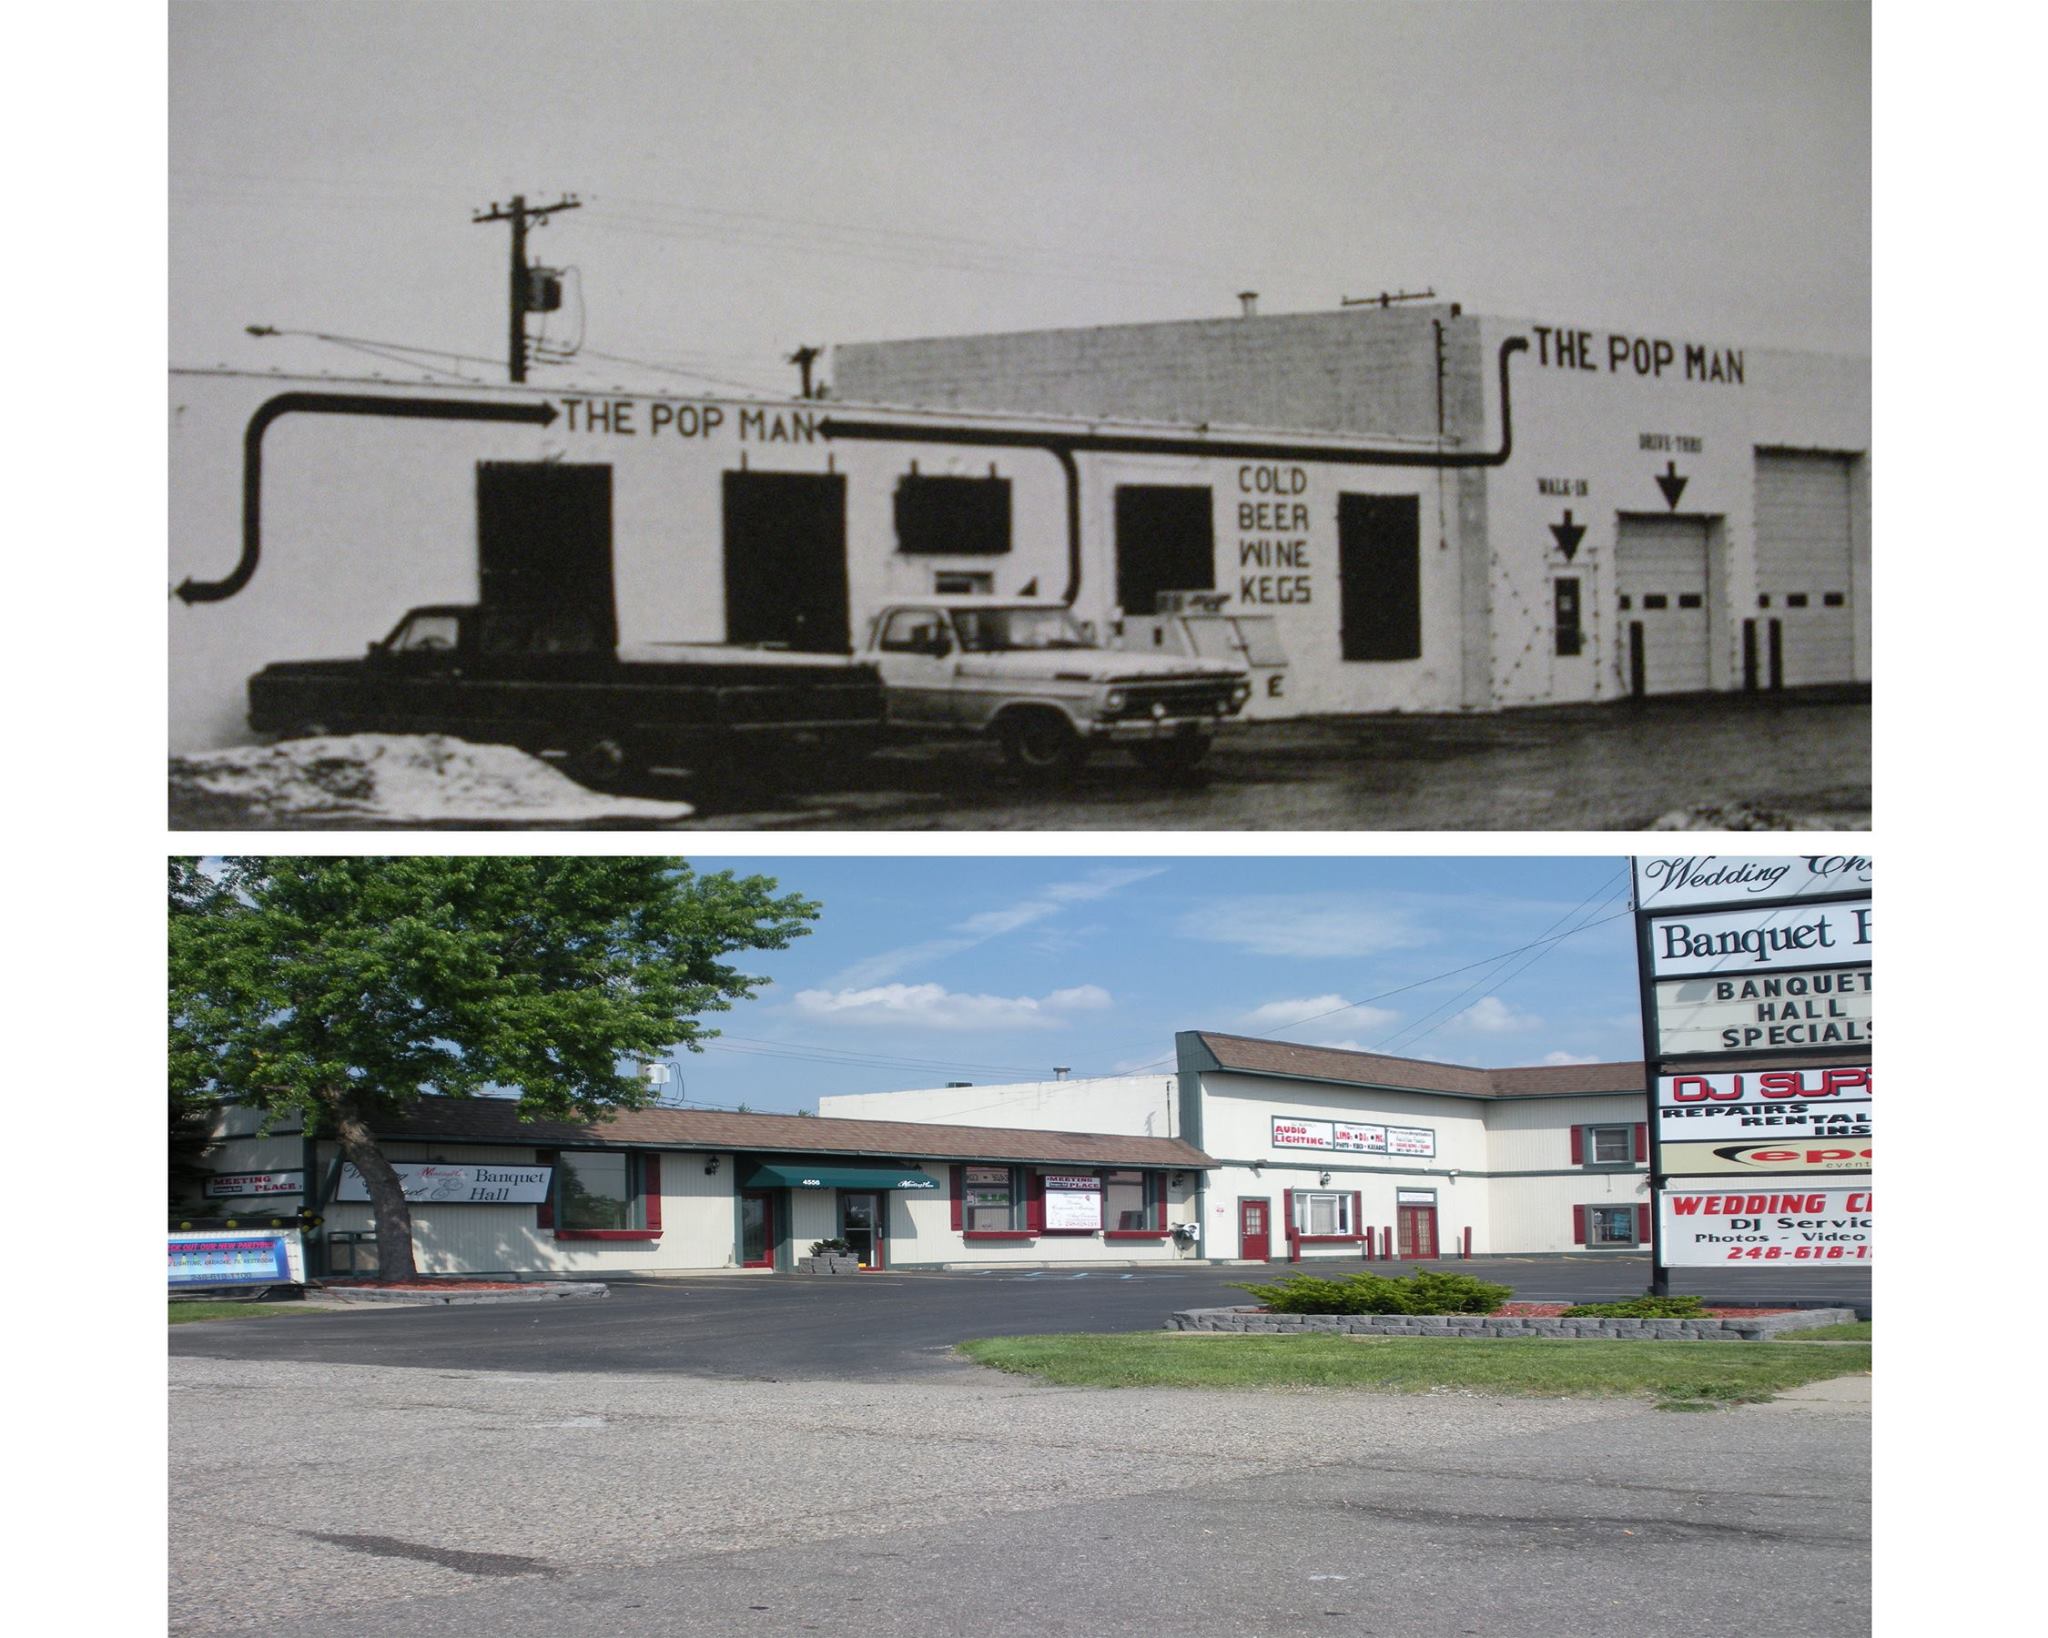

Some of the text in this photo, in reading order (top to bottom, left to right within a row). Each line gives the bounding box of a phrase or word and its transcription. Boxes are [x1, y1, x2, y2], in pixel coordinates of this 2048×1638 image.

[1533, 326, 1744, 384] THE POP MAN
[561, 399, 814, 443] THE POP MAN
[1238, 466, 1307, 495] COLD
[1537, 477, 1589, 497] WALK-IN
[1238, 502, 1309, 531] BEER
[1239, 540, 1311, 568] WINE
[1240, 575, 1312, 604] KEGS
[1645, 856, 1872, 893] Wedding Ch
[1660, 914, 1837, 962] Banquet
[1717, 972, 1872, 1001] BANQUET
[1757, 998, 1847, 1022] HALL
[1673, 1067, 1872, 1102] DJ SUP
[1662, 1103, 1809, 1119] REPAIRS
[1275, 1125, 1307, 1134] AUDIO
[1275, 1134, 1324, 1146] LIGHTING
[213, 1175, 272, 1186] MEETING
[255, 1183, 297, 1192] PLACE
[475, 1168, 545, 1186] Banquet
[469, 1187, 510, 1201] Hall
[1673, 1193, 1827, 1215] WEDDING
[1731, 1218, 1761, 1232] DJ
[1695, 1233, 1769, 1243] Photos
[1802, 1232, 1866, 1242] Video
[1727, 1245, 1872, 1260] 248-618-1
